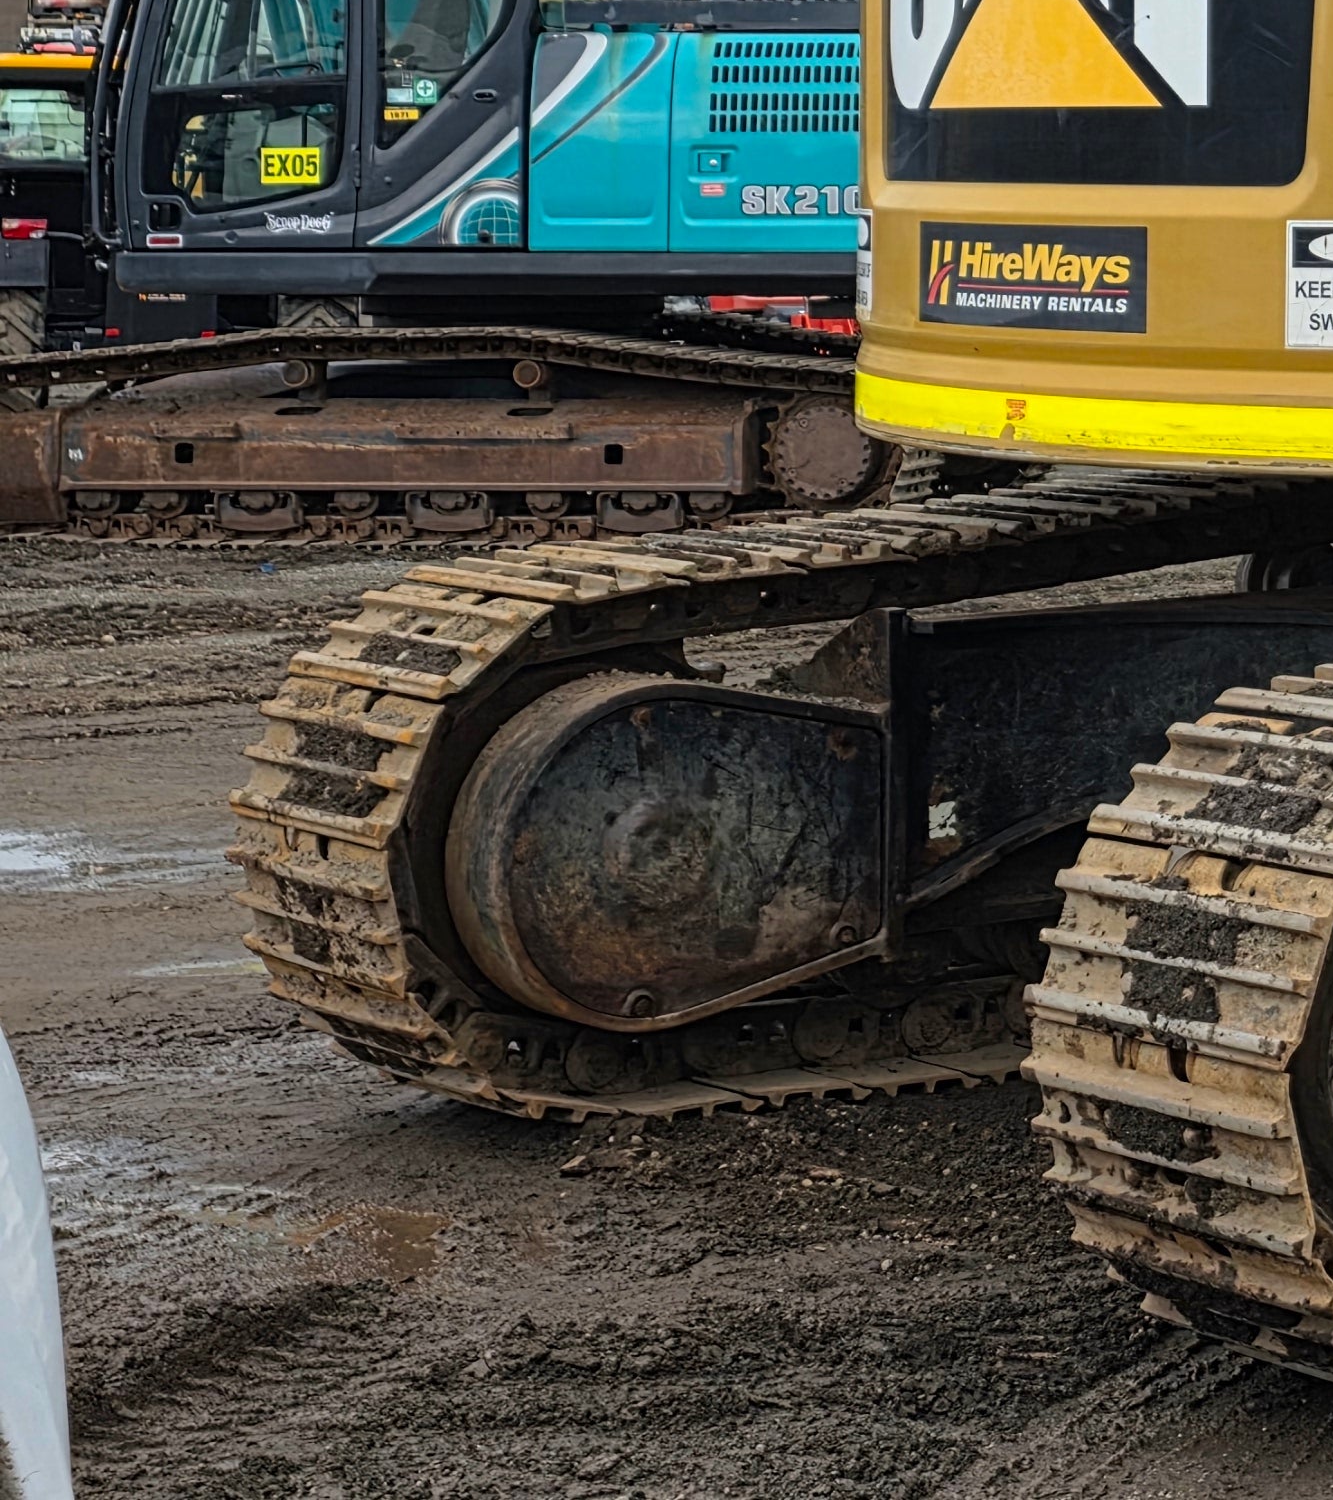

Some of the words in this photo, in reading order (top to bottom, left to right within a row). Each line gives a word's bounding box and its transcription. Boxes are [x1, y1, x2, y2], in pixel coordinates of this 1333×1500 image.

[264, 154, 318, 177] EX05
[958, 241, 1131, 292] HireWays
[955, 292, 1042, 310] MACHINERY
[1047, 297, 1128, 313] RENTALS
